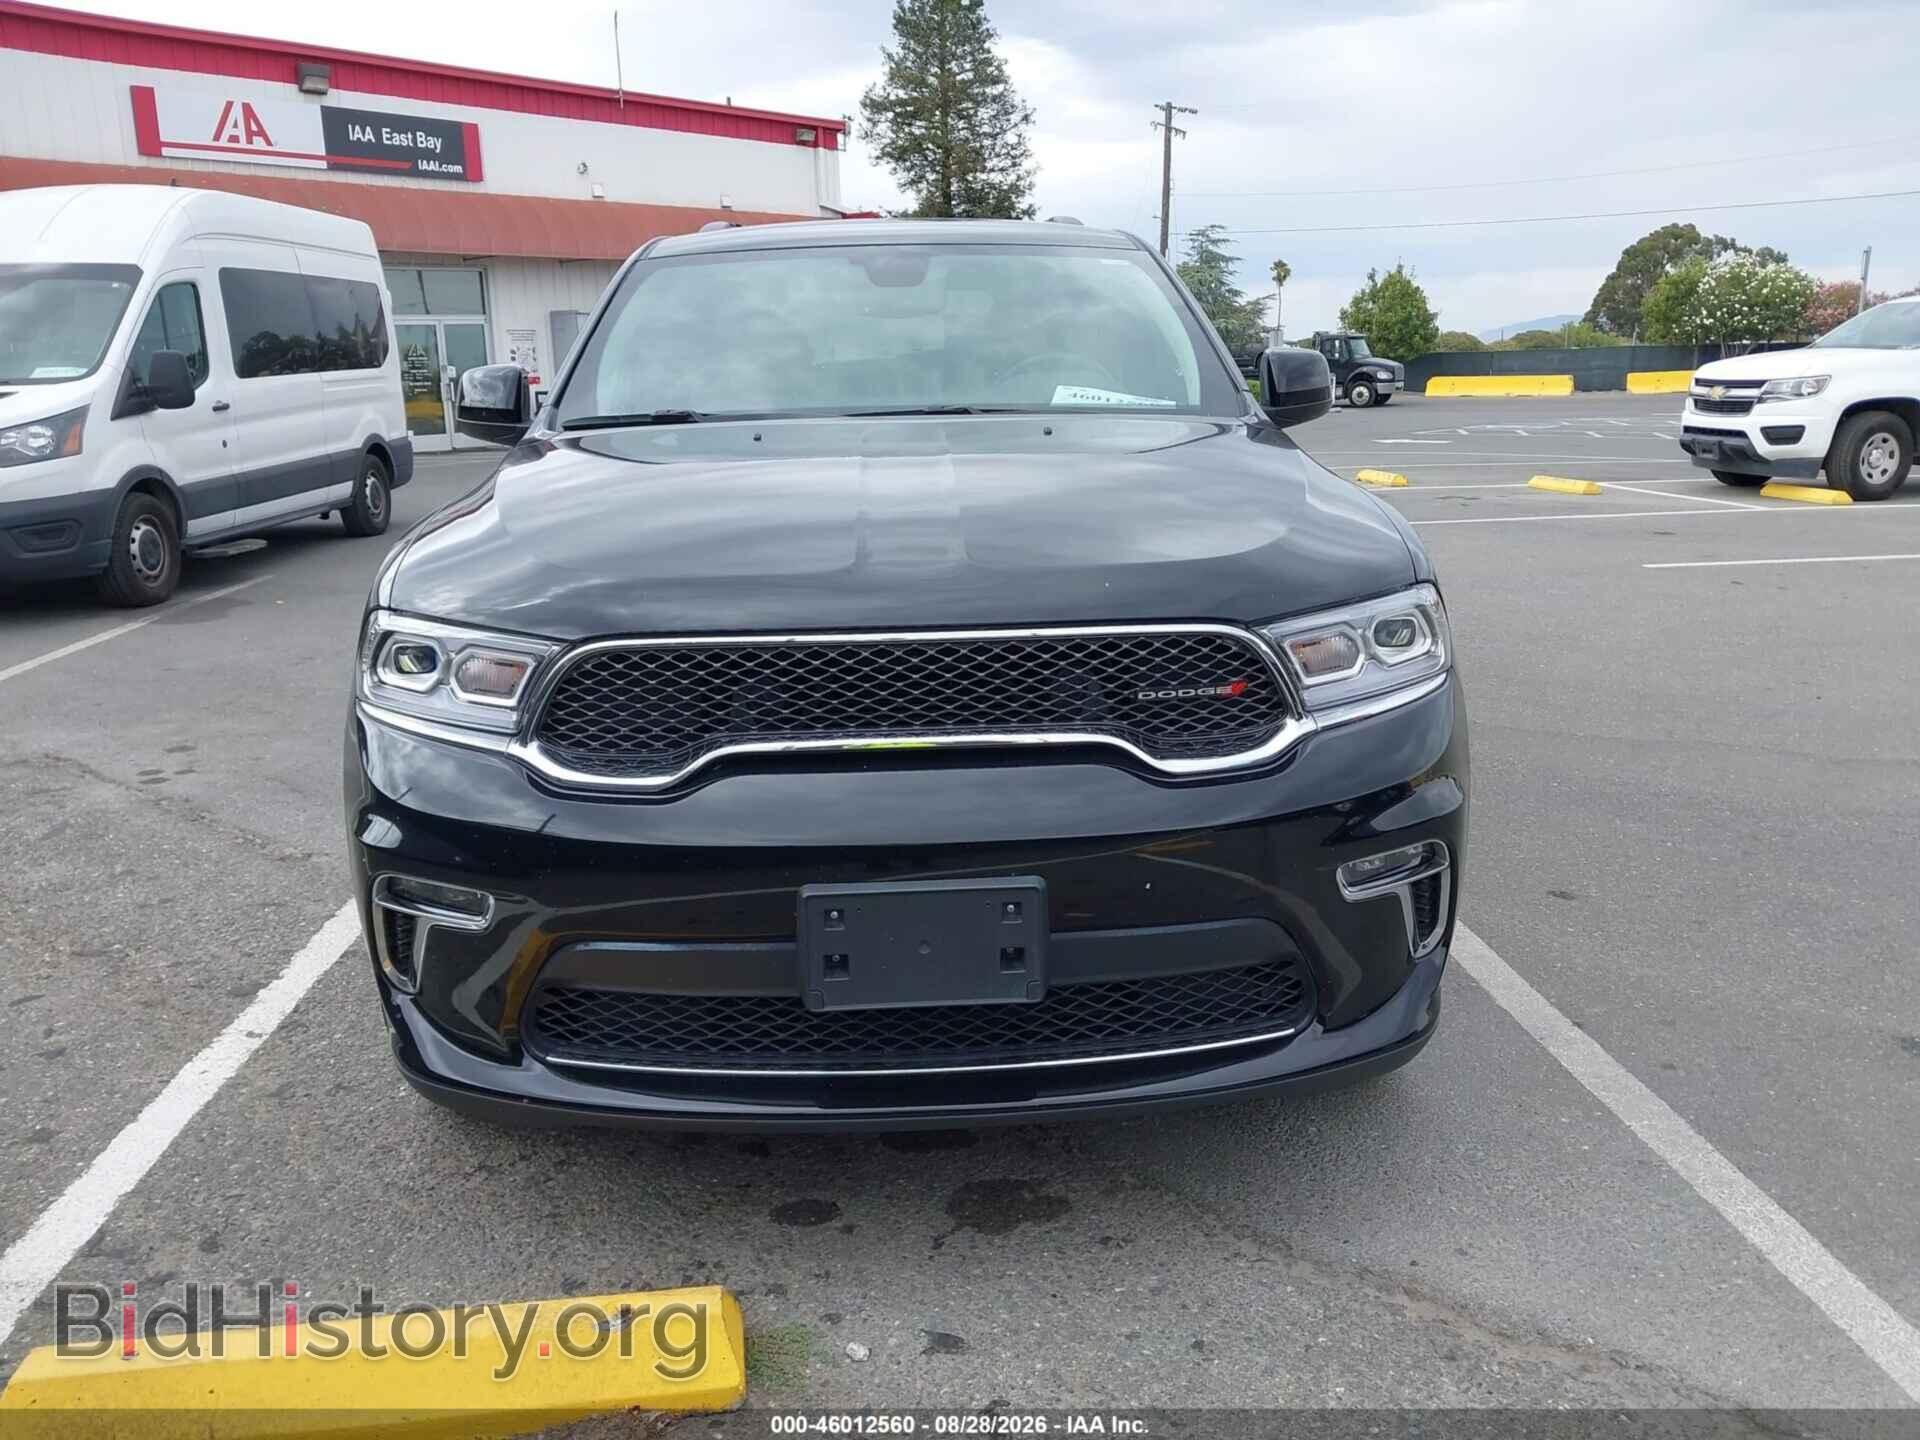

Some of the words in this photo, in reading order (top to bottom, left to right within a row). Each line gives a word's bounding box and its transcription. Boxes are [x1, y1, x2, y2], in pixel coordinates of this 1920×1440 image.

[347, 123, 375, 143] IAA
[382, 128, 413, 147] East
[416, 131, 442, 153] Bay
[1138, 686, 1232, 699] DODGE
